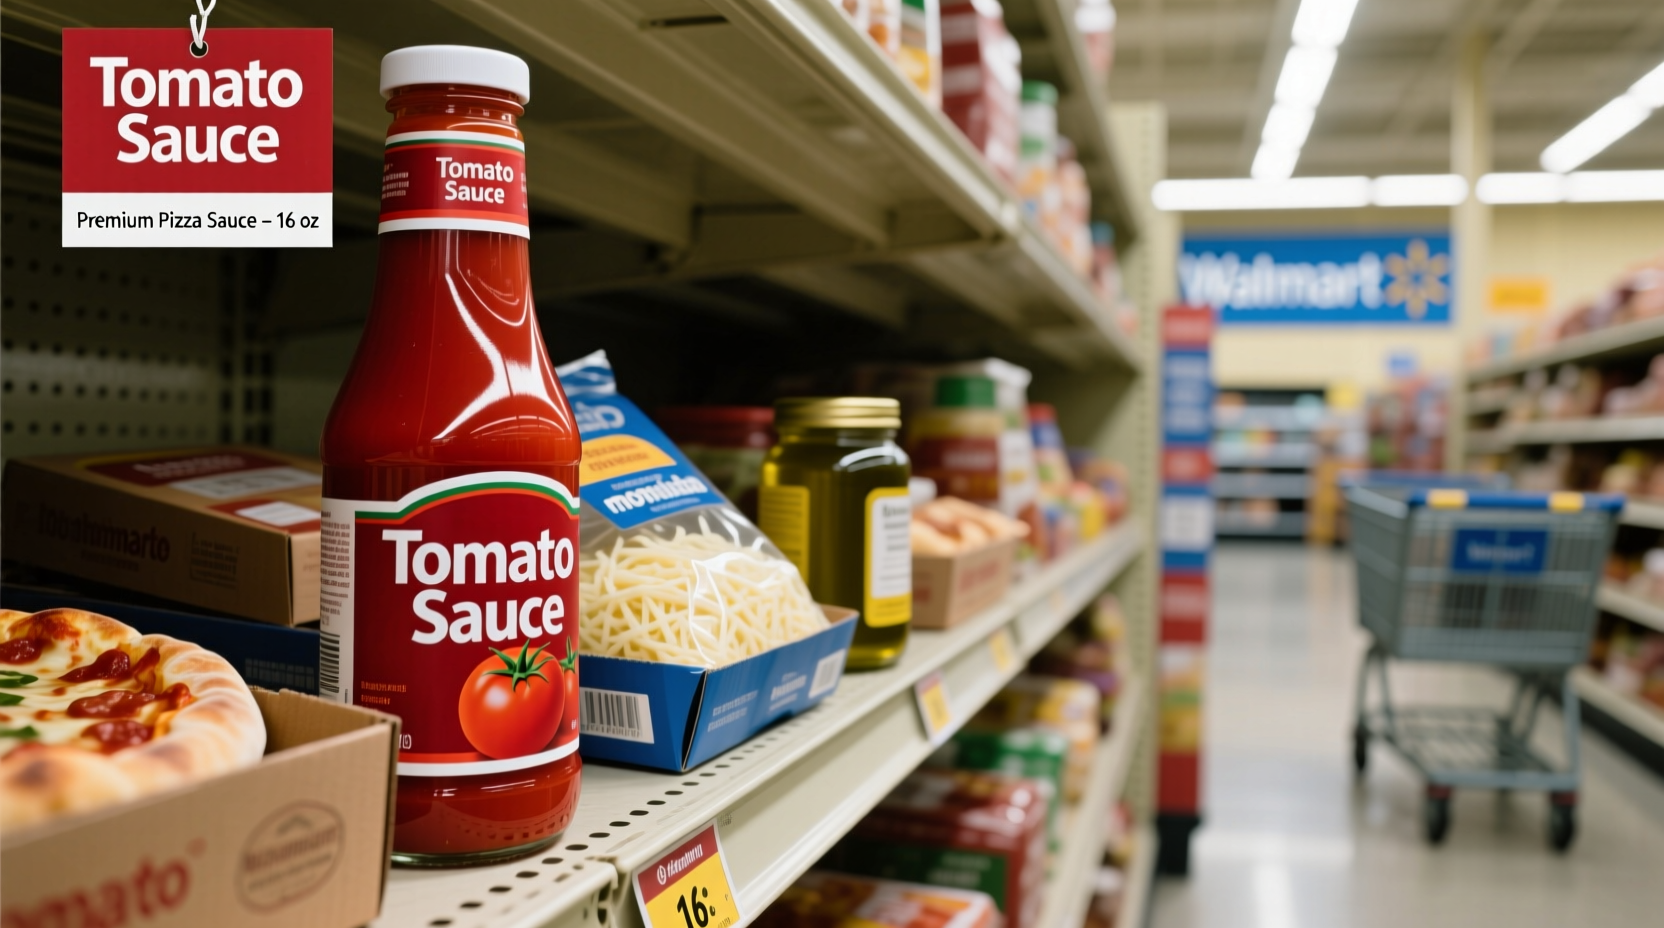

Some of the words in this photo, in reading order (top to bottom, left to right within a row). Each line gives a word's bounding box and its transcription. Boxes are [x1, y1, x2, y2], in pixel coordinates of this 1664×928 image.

[90, 56, 304, 108] Tomato
[116, 114, 281, 164] Sauce
[435, 156, 515, 183] Tomato
[444, 180, 506, 205] Sauce
[77, 211, 154, 229] Premium
[159, 211, 202, 229] Pizza
[207, 211, 257, 229] Sauce
[276, 212, 296, 229] 16
[300, 215, 320, 229] oz
[382, 528, 575, 585] Tomato
[411, 588, 565, 645] Sauce
